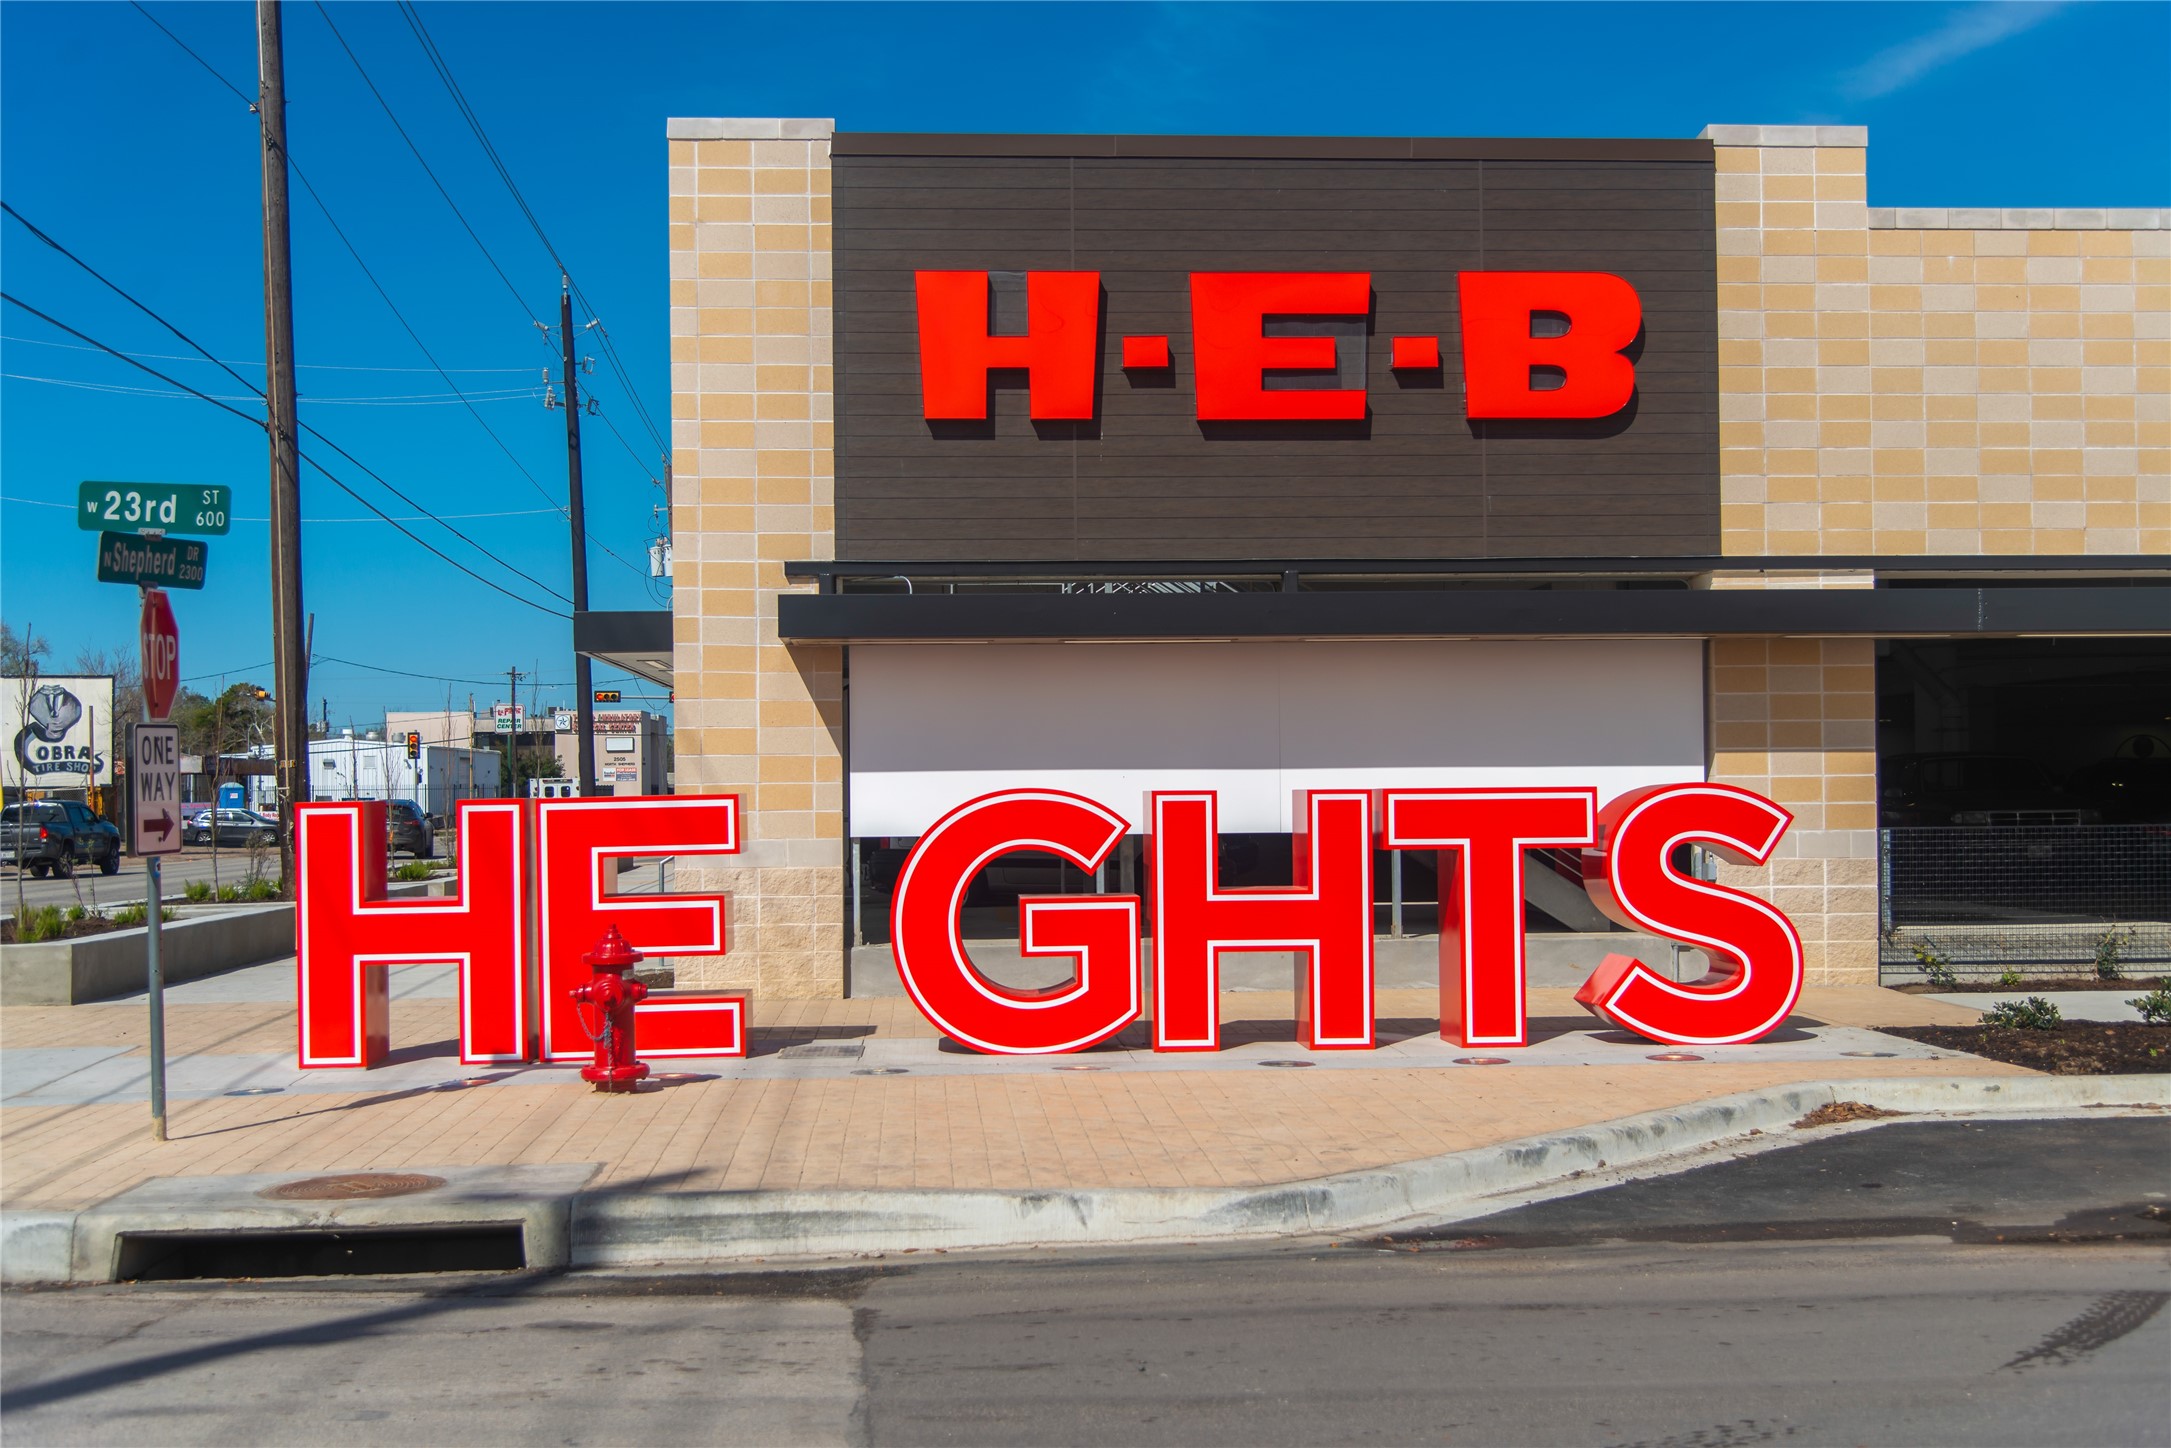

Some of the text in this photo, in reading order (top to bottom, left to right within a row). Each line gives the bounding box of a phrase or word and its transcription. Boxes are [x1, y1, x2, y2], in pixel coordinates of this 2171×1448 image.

[915, 270, 1642, 420] H-E-B
[87, 490, 220, 524] W 23rd ST
[196, 511, 225, 527] 600
[104, 541, 200, 581] N Shepherd DR
[179, 564, 204, 581] 2300
[142, 632, 177, 681] STOP
[142, 735, 174, 765] ONE
[33, 763, 62, 773] TIRE
[140, 772, 175, 802] WAY
